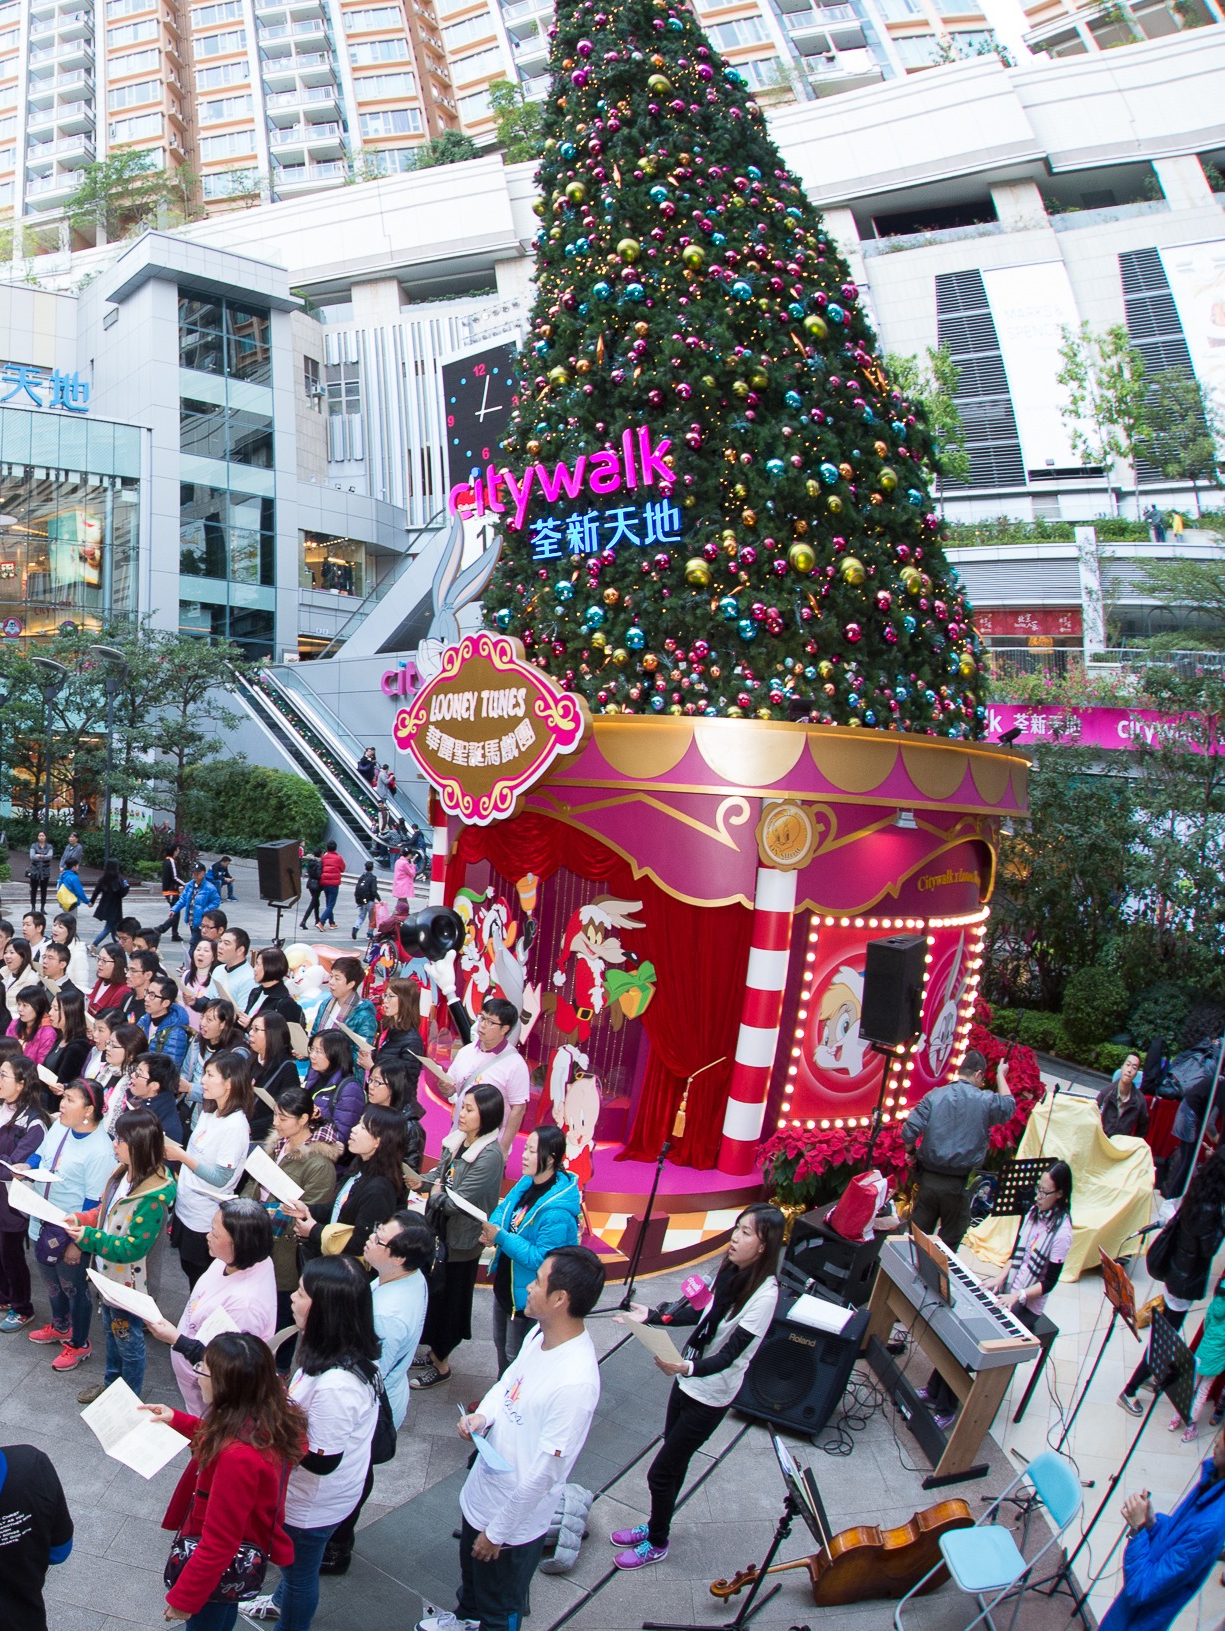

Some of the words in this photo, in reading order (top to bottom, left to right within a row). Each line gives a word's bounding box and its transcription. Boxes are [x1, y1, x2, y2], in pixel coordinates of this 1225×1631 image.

[472, 363, 486, 377] 12
[447, 415, 455, 428] 9
[481, 447, 491, 460] 6
[448, 424, 678, 530] citywalk
[528, 498, 682, 562] 荃新天地
[429, 691, 478, 722] LOONEY
[480, 687, 527, 719] TUNES
[788, 1333, 816, 1348] Roland
